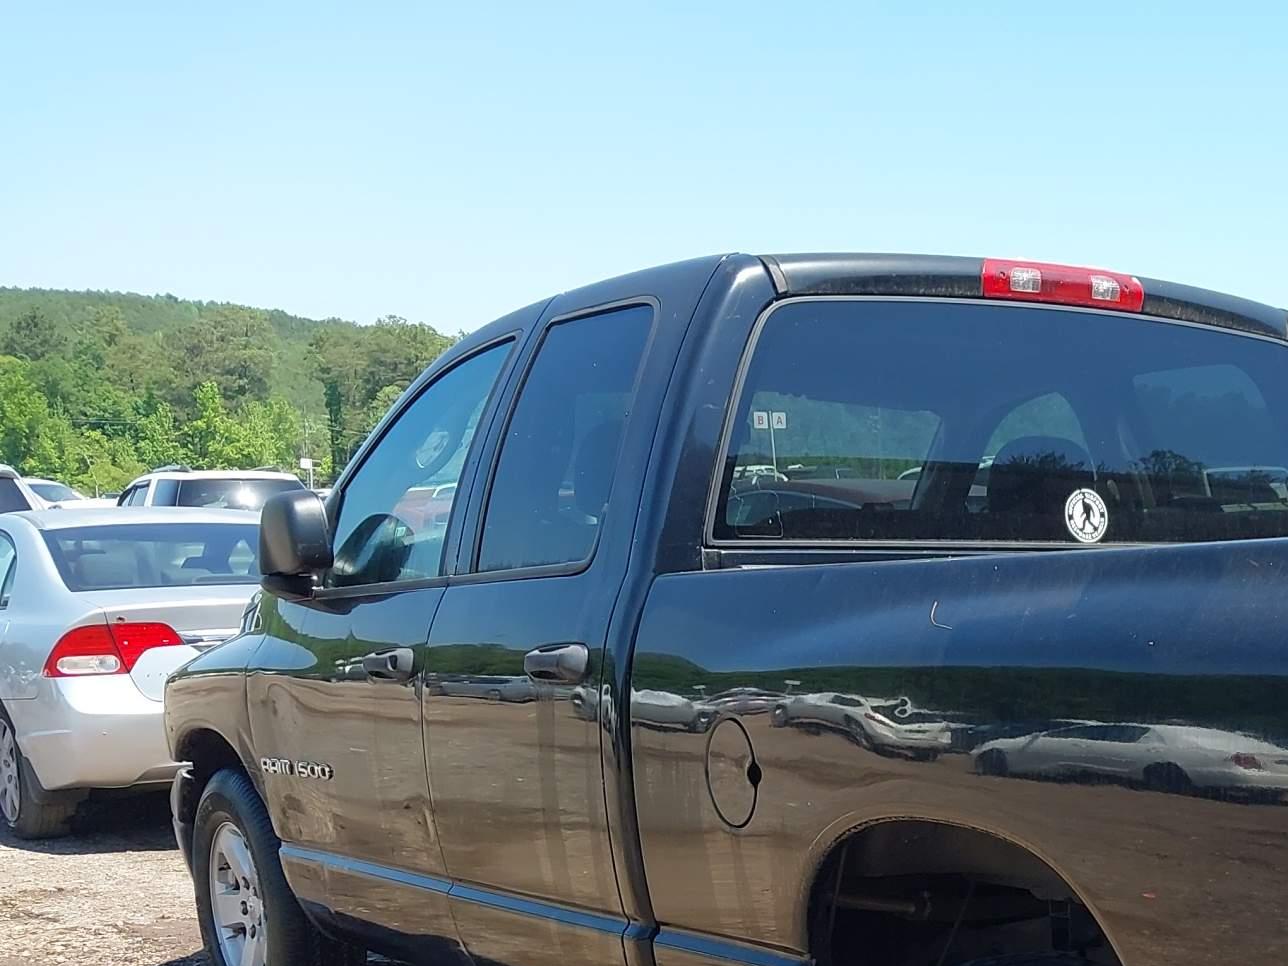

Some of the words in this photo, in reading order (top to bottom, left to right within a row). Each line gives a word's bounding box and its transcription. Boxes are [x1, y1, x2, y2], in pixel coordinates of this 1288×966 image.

[757, 415, 764, 425] B
[776, 415, 783, 425] A
[260, 757, 292, 775] RAM
[294, 760, 333, 780] 1500
